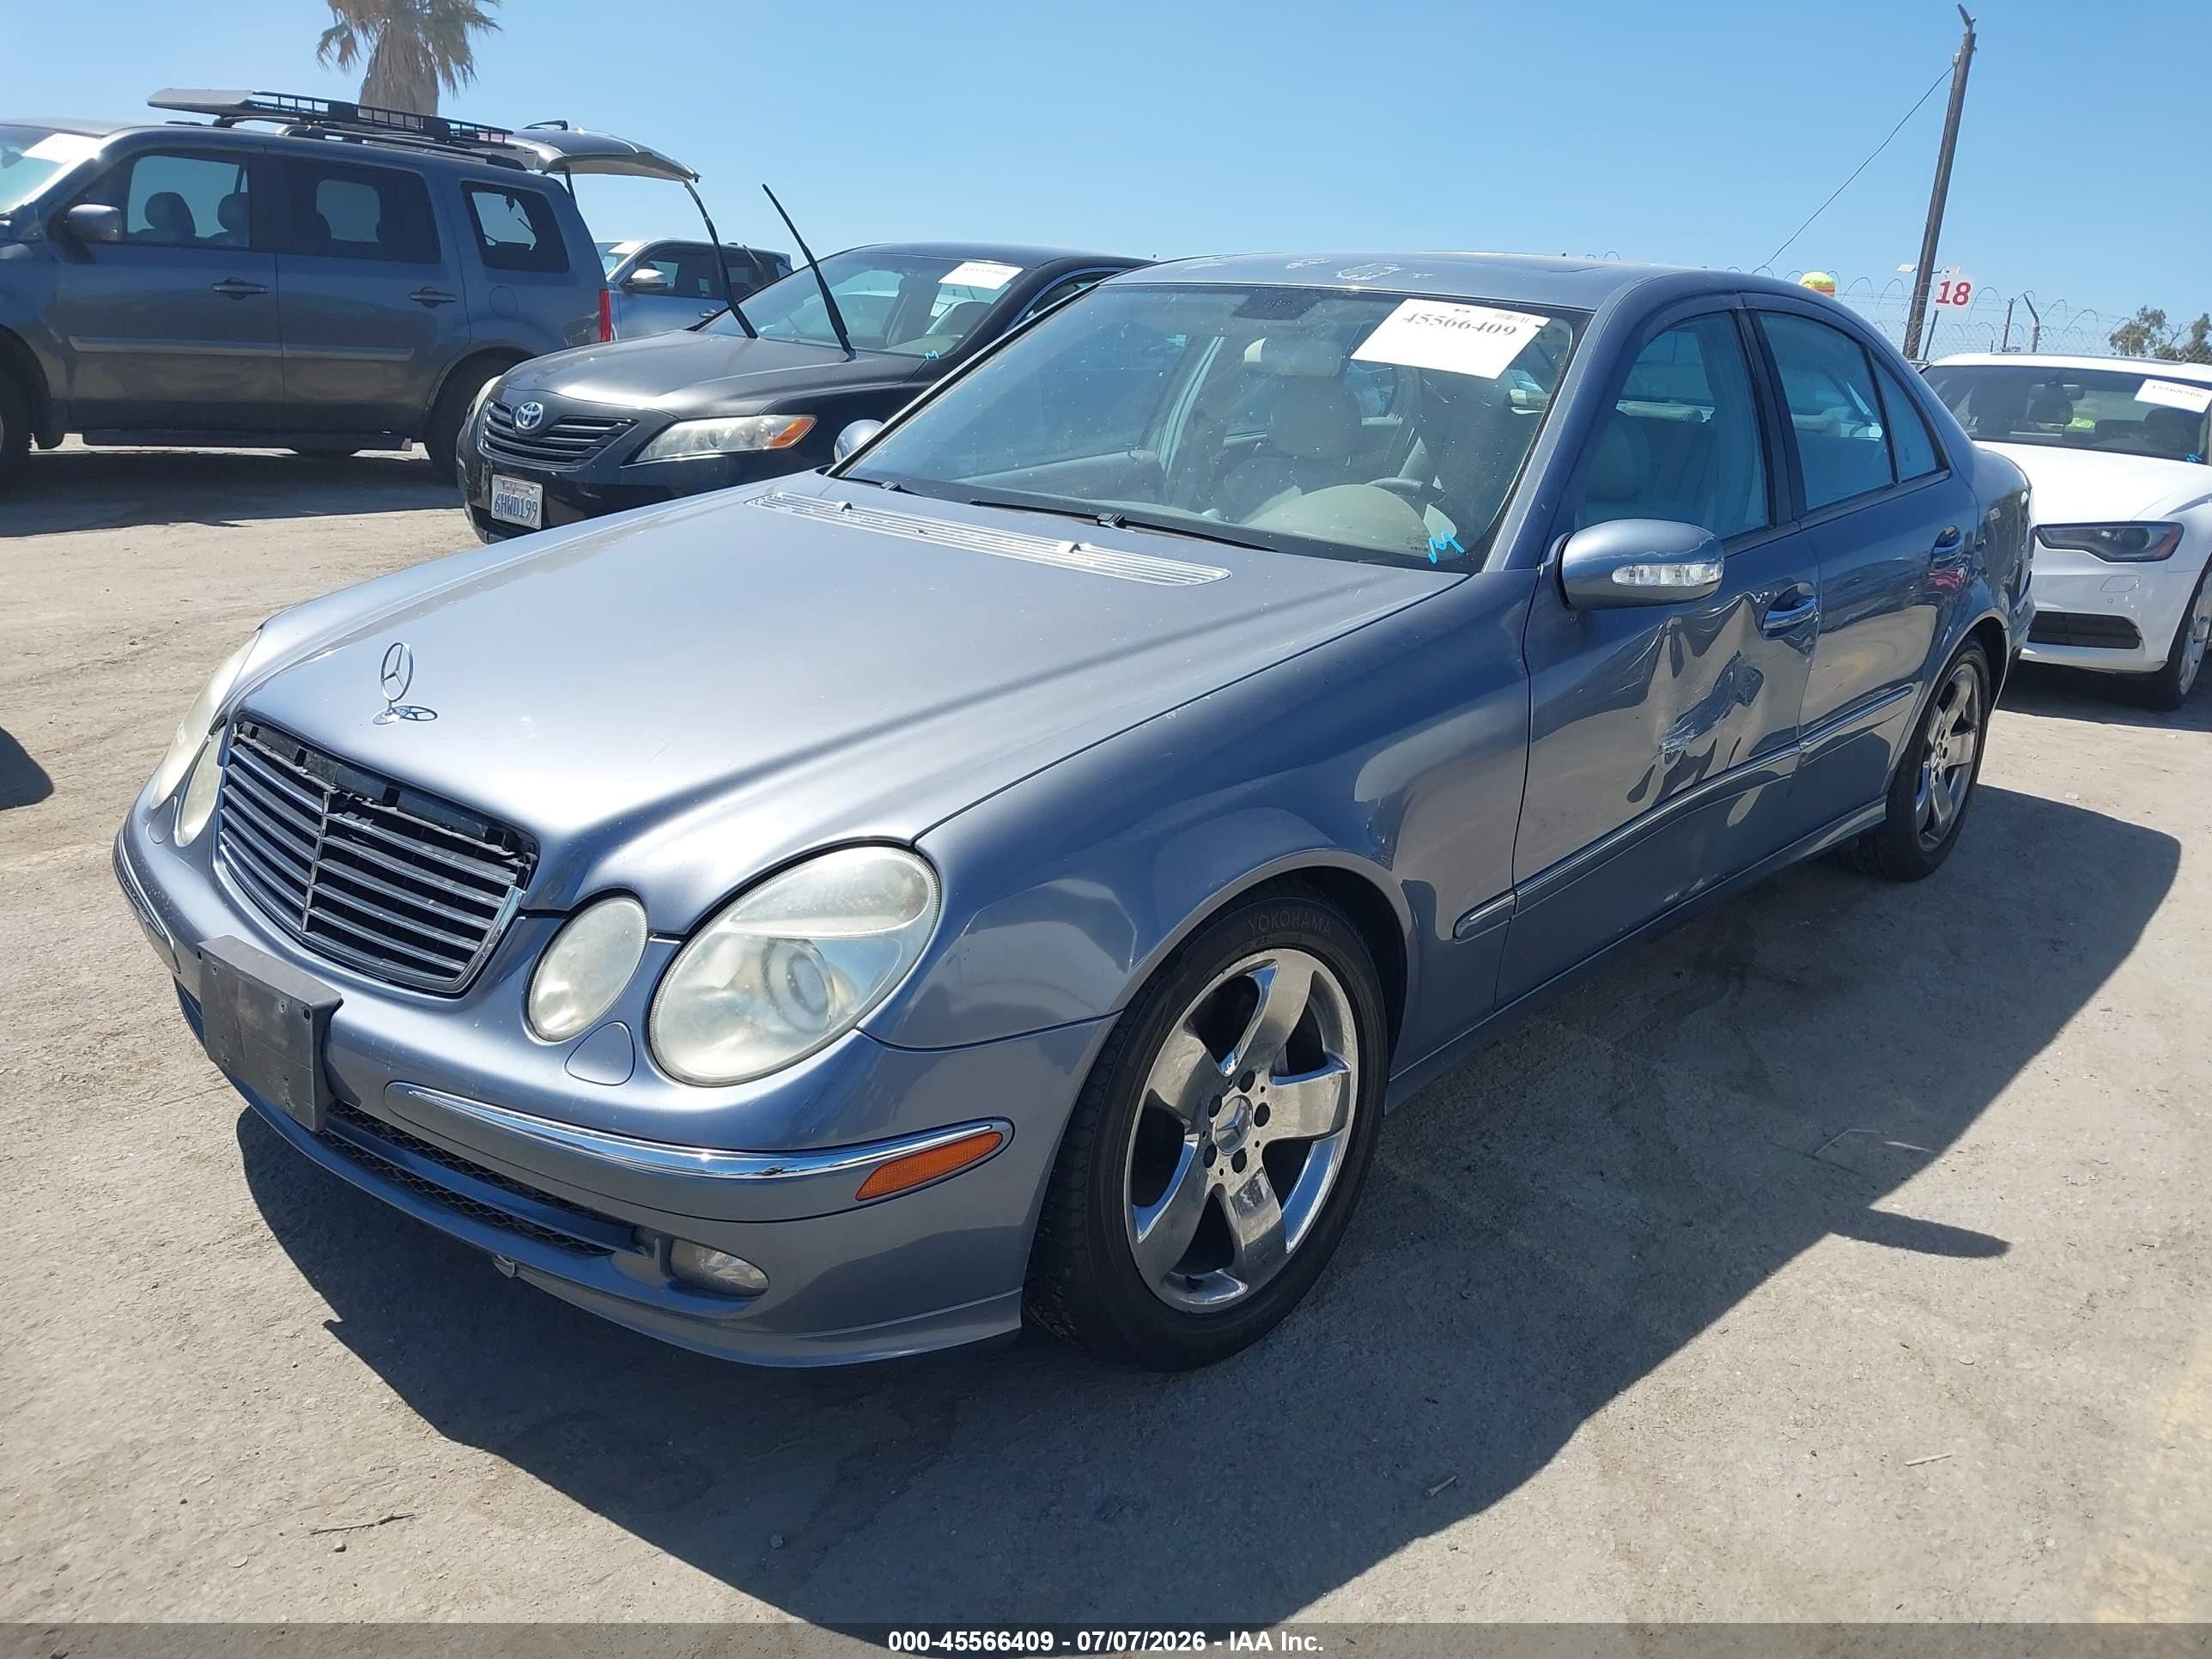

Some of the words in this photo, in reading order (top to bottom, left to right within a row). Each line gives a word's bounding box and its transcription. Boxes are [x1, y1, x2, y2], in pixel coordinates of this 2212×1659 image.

[1936, 281, 1971, 306] 18
[1403, 313, 1517, 336] 45566409
[495, 493, 538, 522] 6HWD199
[1248, 910, 1332, 936] YOKOHAMA
